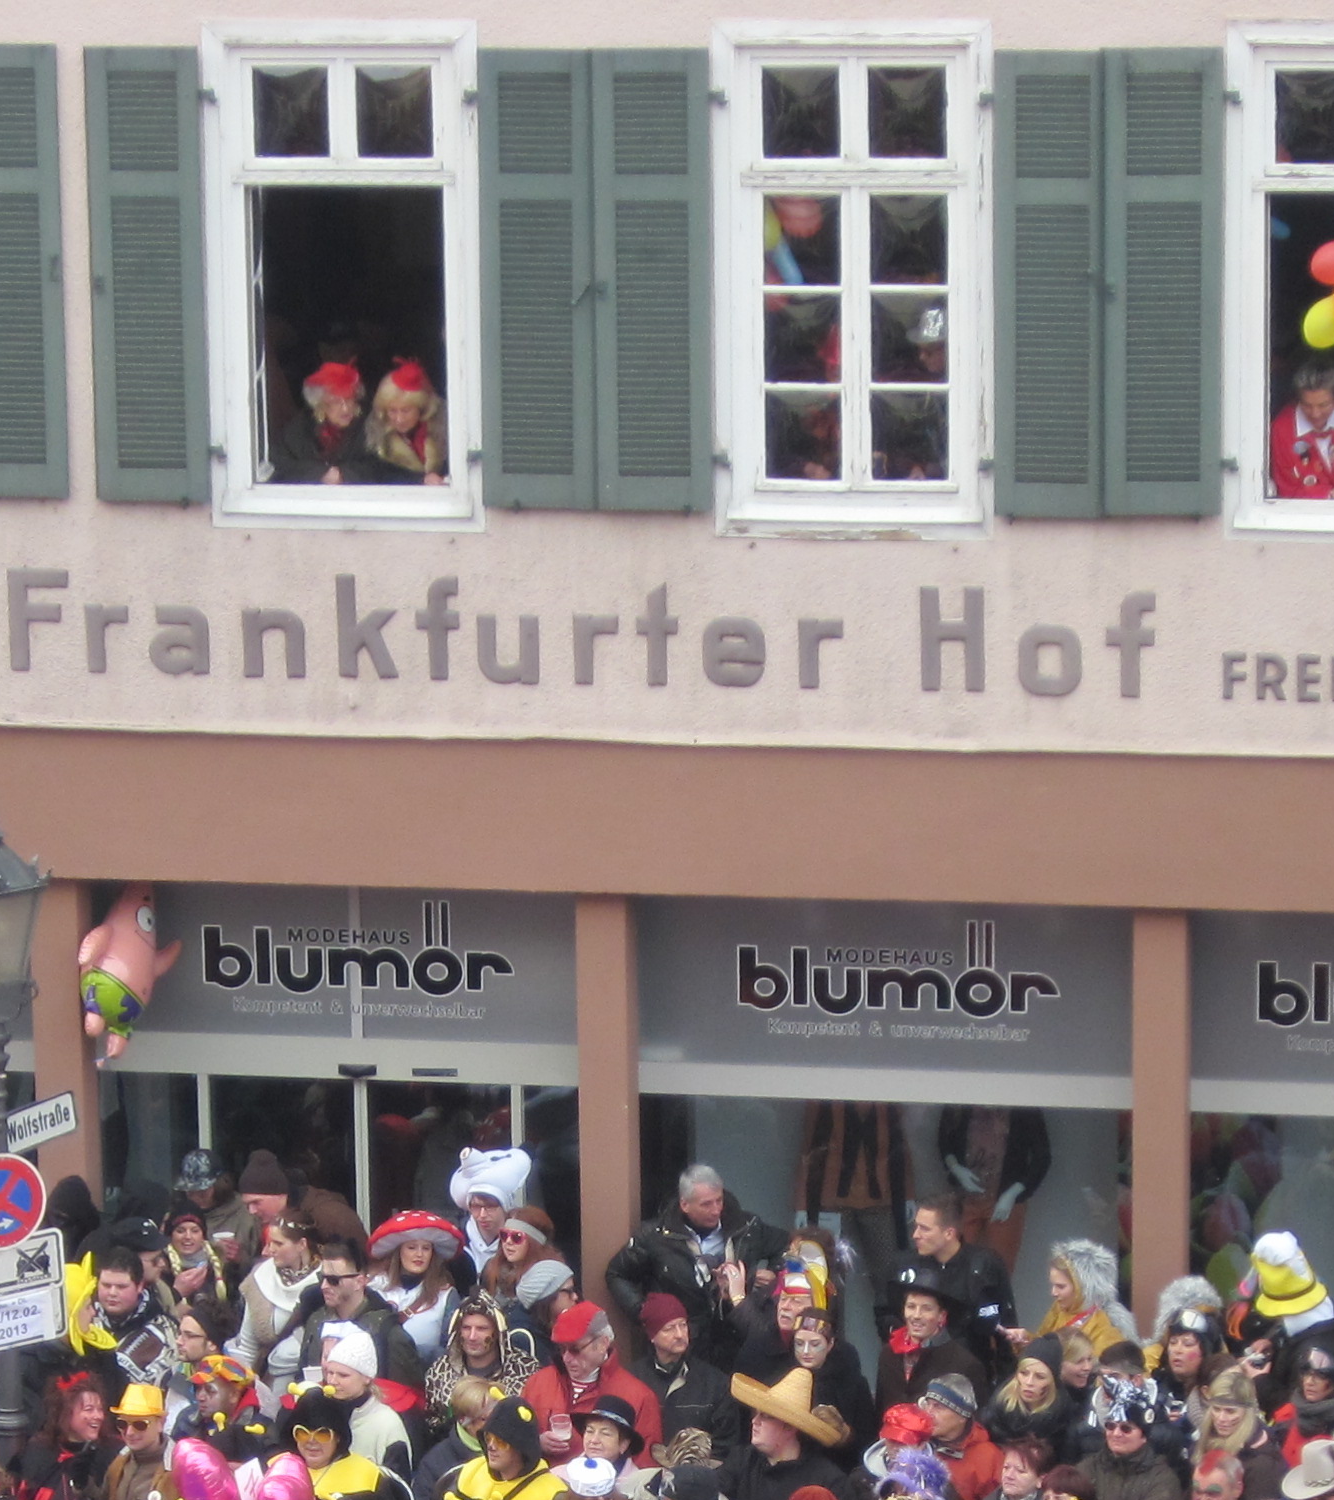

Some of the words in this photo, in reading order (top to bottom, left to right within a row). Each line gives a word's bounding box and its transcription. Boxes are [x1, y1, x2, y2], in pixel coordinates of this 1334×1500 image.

[6, 567, 844, 689] Frankfurter
[920, 586, 1157, 698] Hof
[287, 928, 411, 945] MODEHAUS
[202, 901, 514, 997] blumör
[826, 948, 954, 965] MODEHAUS
[737, 920, 1060, 1018] blumör
[233, 997, 322, 1016] Kompetent
[330, 1000, 343, 1014] &
[768, 1018, 860, 1038] Kompetent
[868, 1022, 882, 1037] &
[891, 1023, 1030, 1042] unverwechselbar
[7, 1103, 70, 1145] Wolfstraße
[0, 1323, 28, 1340] 2013
